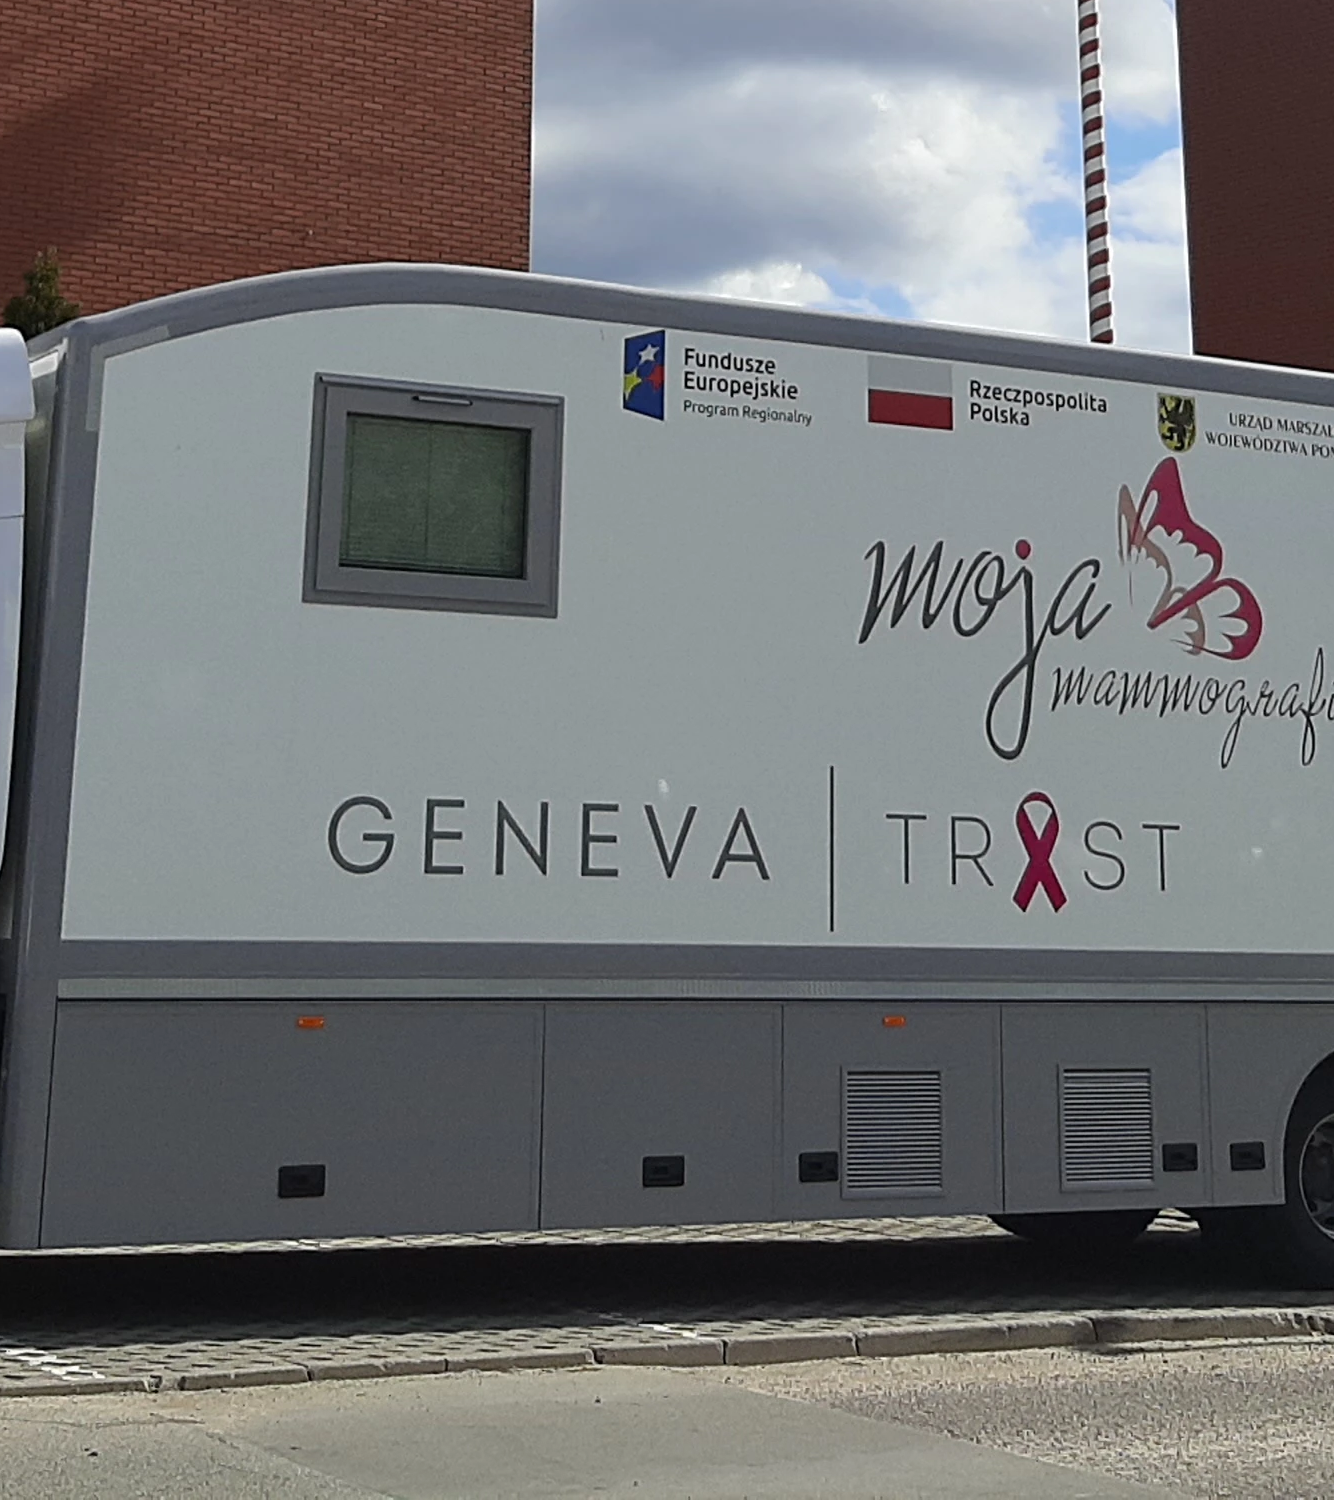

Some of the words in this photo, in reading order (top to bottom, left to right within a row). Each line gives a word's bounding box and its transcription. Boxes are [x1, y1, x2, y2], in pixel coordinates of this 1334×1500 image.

[683, 348, 776, 374] Fundusze
[683, 372, 799, 400] Europejskie
[970, 380, 1108, 413] Rzeczpospolita
[683, 400, 740, 417] Program
[742, 405, 813, 427] Regionalny
[970, 403, 1030, 426] Polska
[1229, 412, 1273, 432] URZĄD
[858, 539, 1113, 761] moja
[327, 796, 770, 881] GENEVA
[884, 791, 1181, 913] TRST
